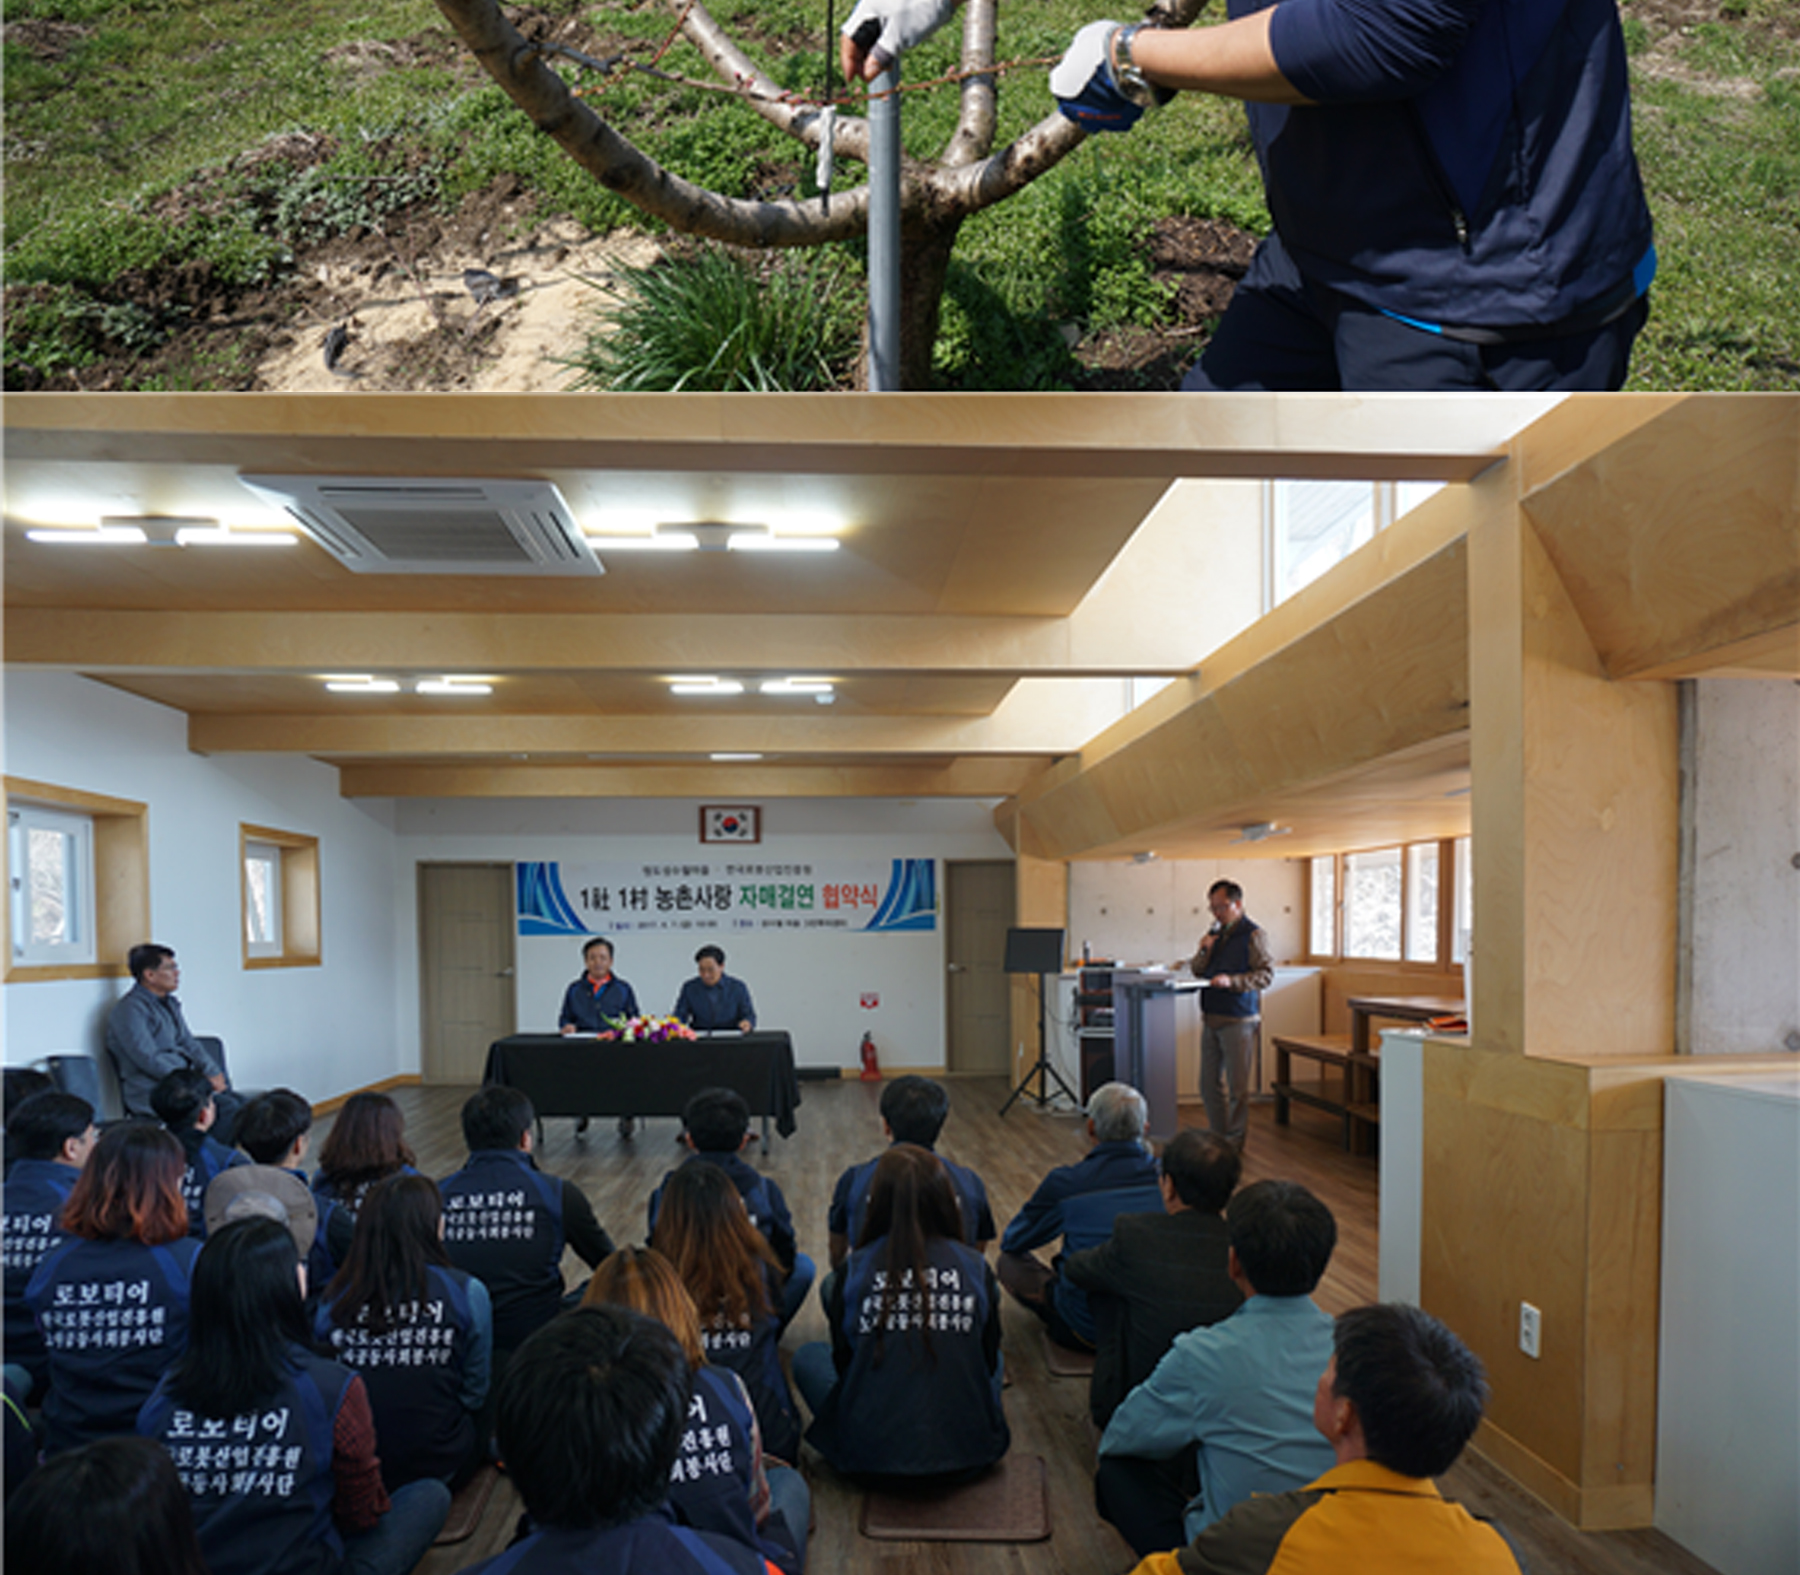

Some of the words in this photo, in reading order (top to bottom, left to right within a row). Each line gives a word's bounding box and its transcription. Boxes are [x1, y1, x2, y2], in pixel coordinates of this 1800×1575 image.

[655, 883, 733, 911] 농촌사랑
[738, 883, 815, 911] 자매결연
[822, 883, 879, 911] 협약식
[53, 1279, 151, 1306] 로보티어
